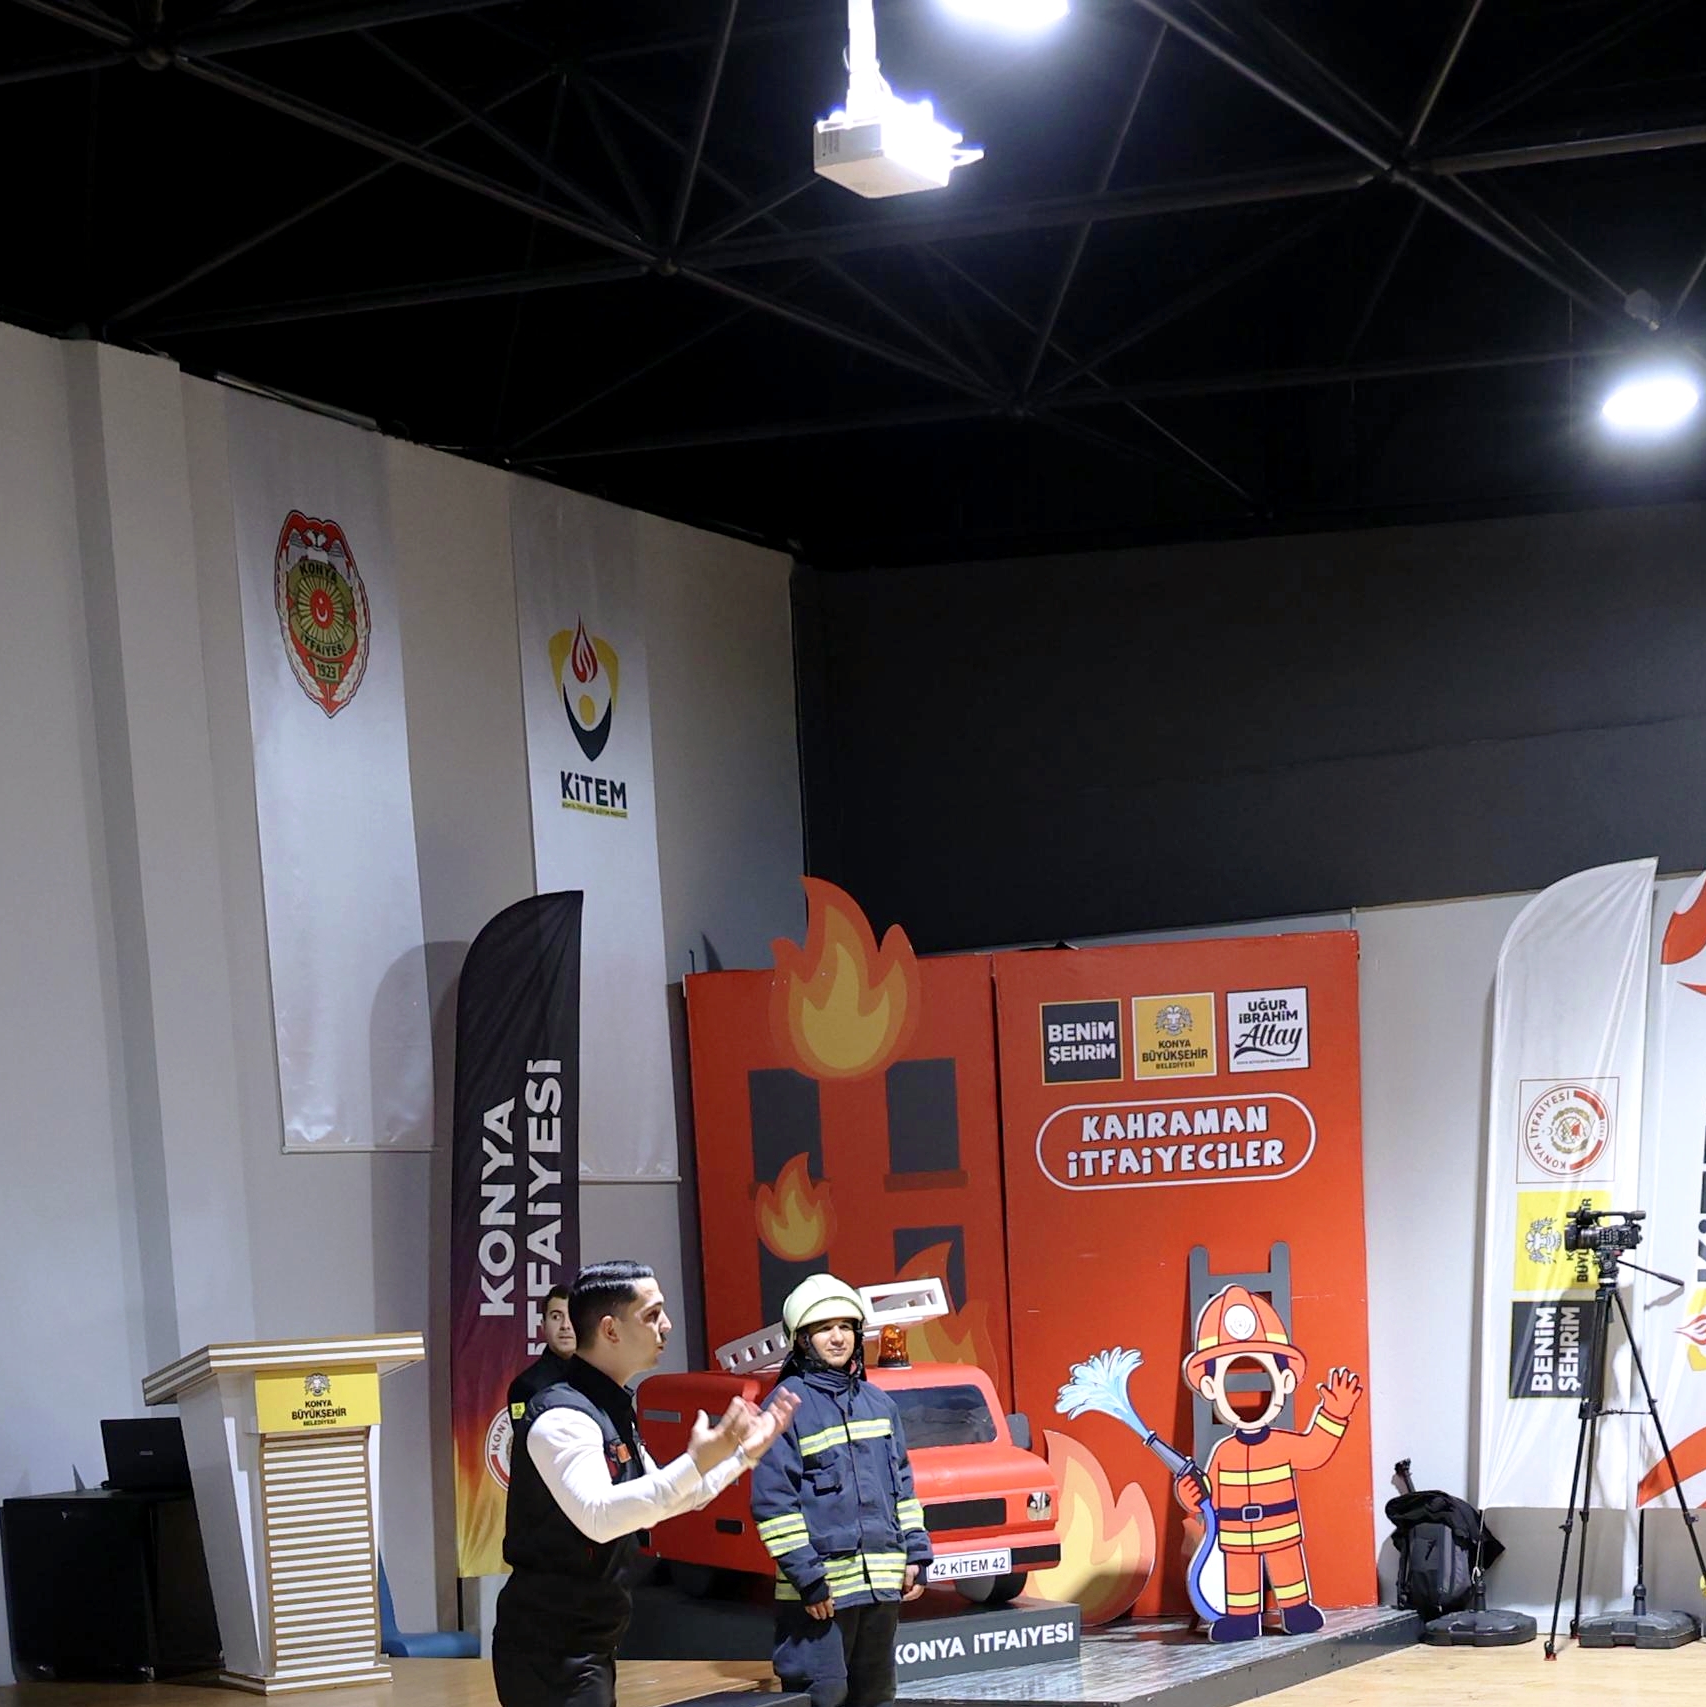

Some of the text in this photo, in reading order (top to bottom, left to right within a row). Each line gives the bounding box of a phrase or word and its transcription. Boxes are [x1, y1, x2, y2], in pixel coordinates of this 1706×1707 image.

[299, 561, 338, 584] KONYA
[316, 661, 337, 679] 1923
[1247, 996, 1288, 1013] UĞUR
[1158, 1039, 1191, 1050] KONYA
[1234, 1022, 1303, 1060] Altay
[1142, 1048, 1209, 1063] BÜYÜKŞEHİR
[1080, 1104, 1269, 1143] KAHRAMAN
[1533, 1141, 1568, 1170] KONYA
[477, 1096, 516, 1317] KONYA
[291, 1407, 347, 1420] BÜYÜKŞEHİR
[304, 1399, 333, 1409] KONYA
[491, 1416, 511, 1452] KONY
[932, 1556, 1006, 1576] 42 KİTEM 42
[973, 1621, 1074, 1655] İTFAİYESİ
